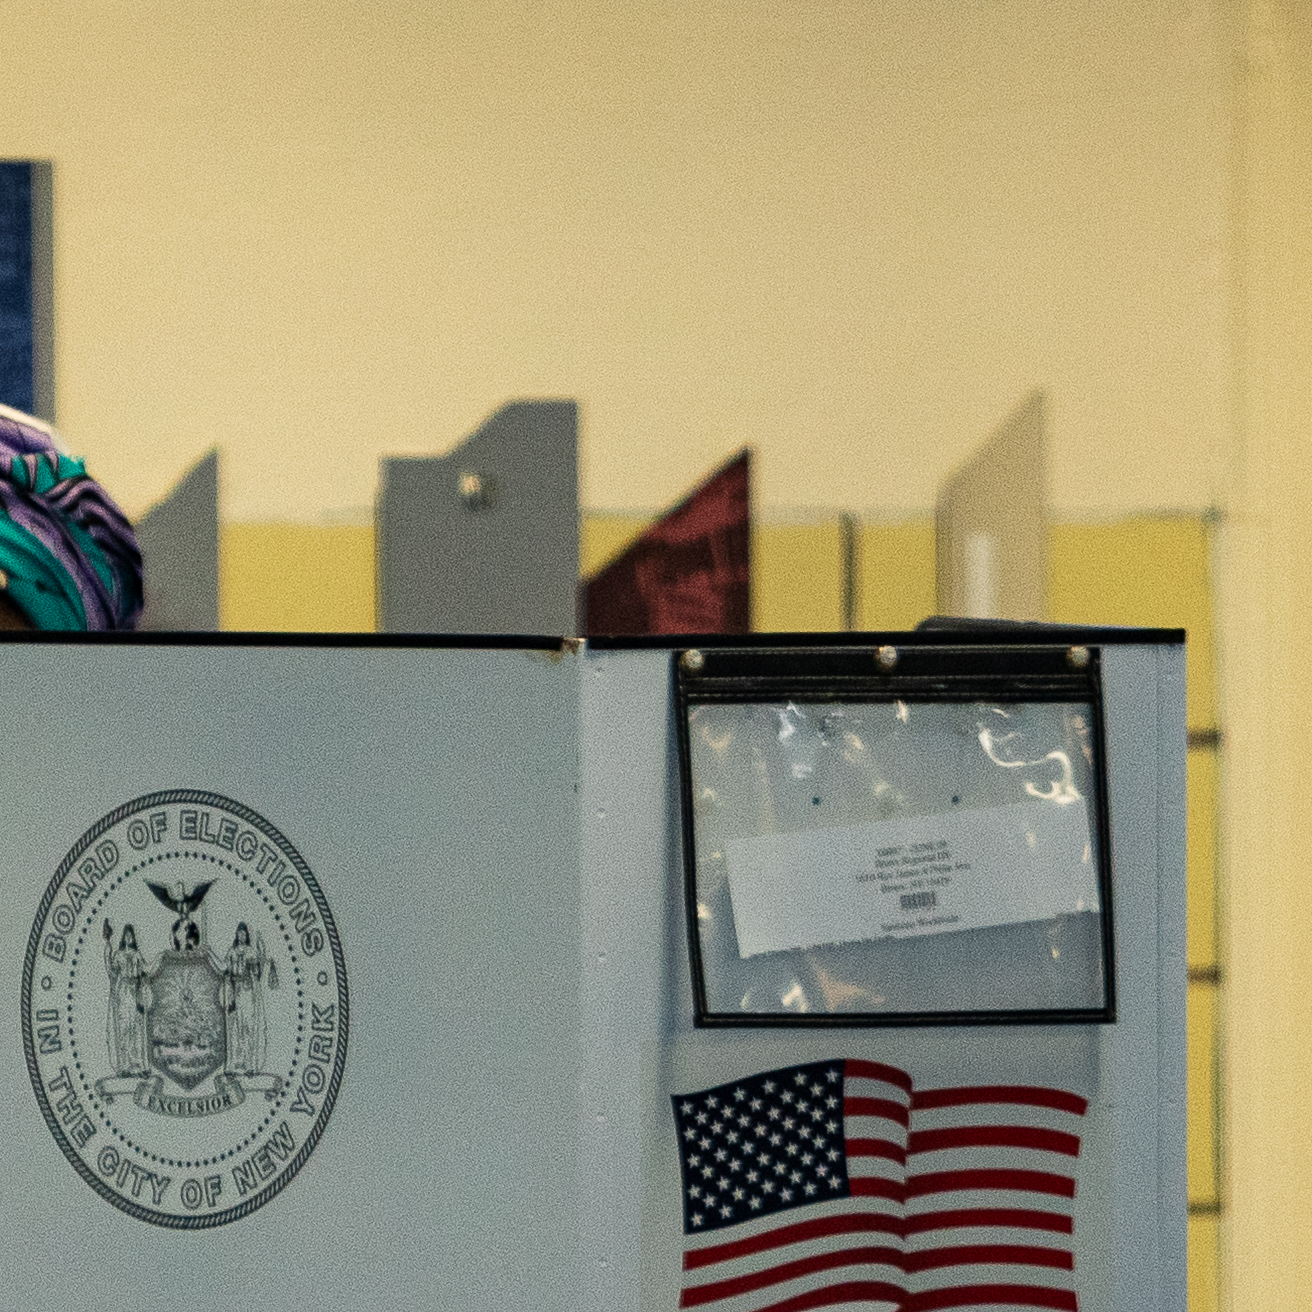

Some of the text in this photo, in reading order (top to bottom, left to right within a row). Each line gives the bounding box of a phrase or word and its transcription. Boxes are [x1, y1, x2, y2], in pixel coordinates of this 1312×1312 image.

[42, 810, 324, 963] BOARD OF ELECTIONS
[36, 1002, 335, 1210] IN THE CITY OF NEW YORK
[147, 1094, 232, 1115] EXCELSIOR
